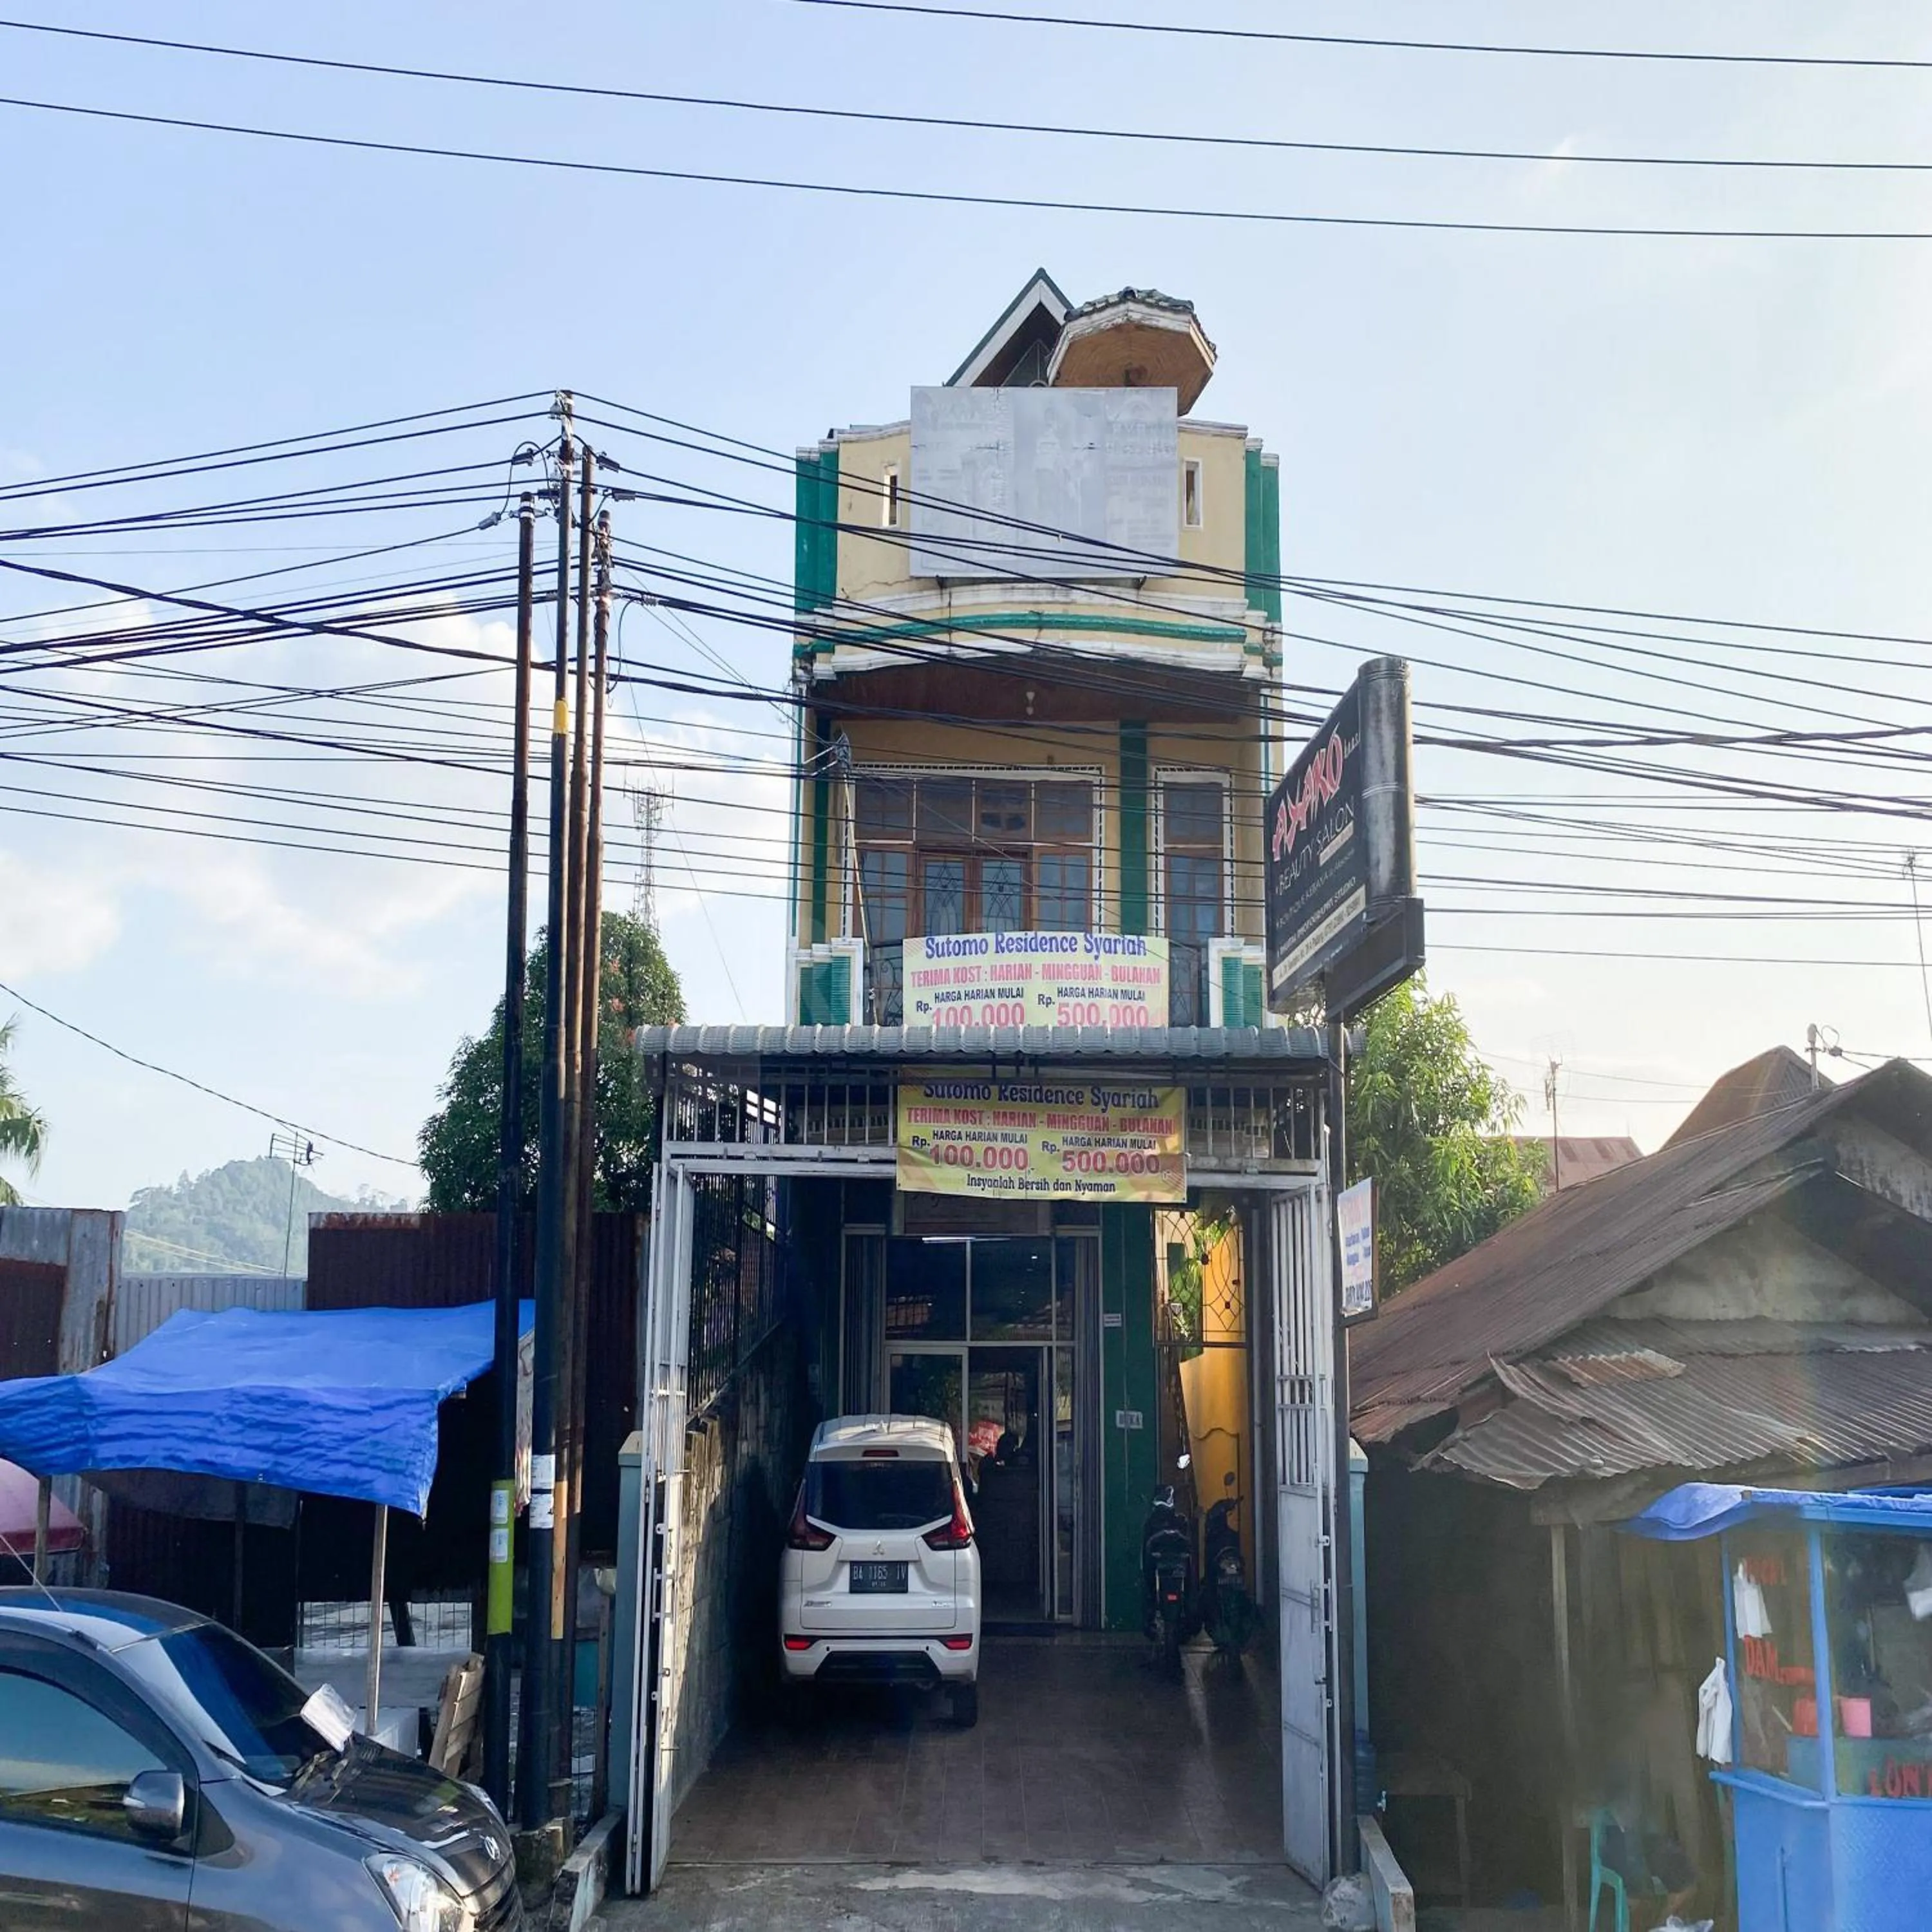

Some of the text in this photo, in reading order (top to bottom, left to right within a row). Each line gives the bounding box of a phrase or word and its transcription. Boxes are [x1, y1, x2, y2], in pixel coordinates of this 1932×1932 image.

[1316, 795, 1354, 855] SALON
[925, 930, 1147, 960] Sutomo Residence Syariah
[911, 968, 951, 988] TERIMA
[952, 965, 982, 984] KOST
[990, 963, 1032, 981] HARIAN
[1041, 963, 1102, 981] MINGGUAN
[1111, 965, 1160, 984] BULANAN
[916, 987, 1024, 1014] Rp. HARGA HARIAN MULAI
[1037, 987, 1146, 1008] Rp. HARGA HARIAN MULAI
[998, 1083, 1084, 1106] Residence
[1090, 1086, 1159, 1113] Syariah
[907, 1107, 951, 1124] TERIMA
[954, 1108, 985, 1125] KOST
[992, 1110, 1037, 1128] HARIAN
[1046, 1113, 1110, 1132] MINGGUAN
[1119, 1117, 1175, 1135] BULANAN
[912, 1130, 1028, 1148] Rp. HARGA HARIAN MULAI
[1041, 1136, 1156, 1154] Rp. HARGA HARIAN MULAI
[1018, 1176, 1050, 1191] Bersih
[1053, 1179, 1072, 1191] dan
[1075, 1180, 1115, 1195] Nyaman
